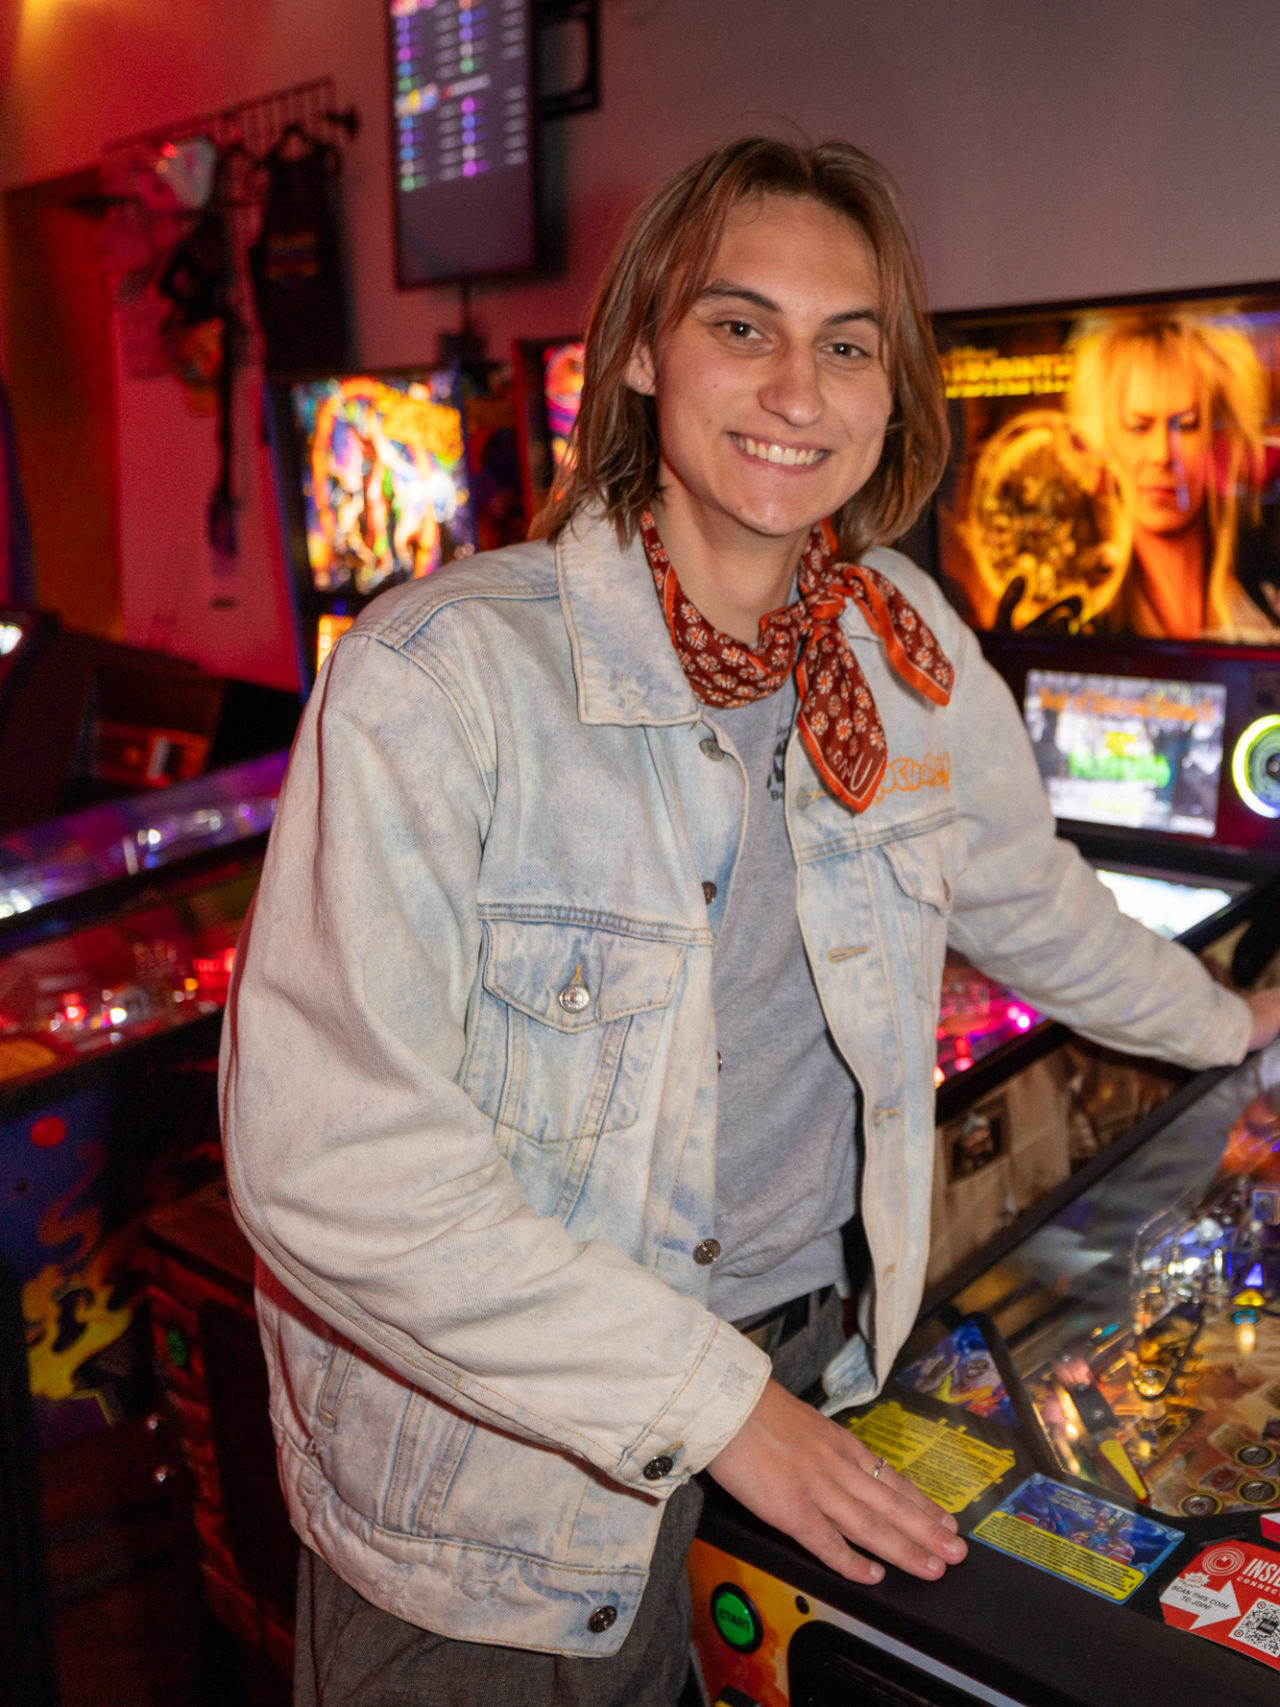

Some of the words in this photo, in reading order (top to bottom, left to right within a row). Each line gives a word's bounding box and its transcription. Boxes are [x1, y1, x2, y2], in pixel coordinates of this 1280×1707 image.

[1171, 1585, 1192, 1595] SCAN
[1192, 1592, 1209, 1602] THIS
[1209, 1599, 1231, 1610] CODE
[1181, 1595, 1192, 1603] TO
[718, 1608, 750, 1632] START
